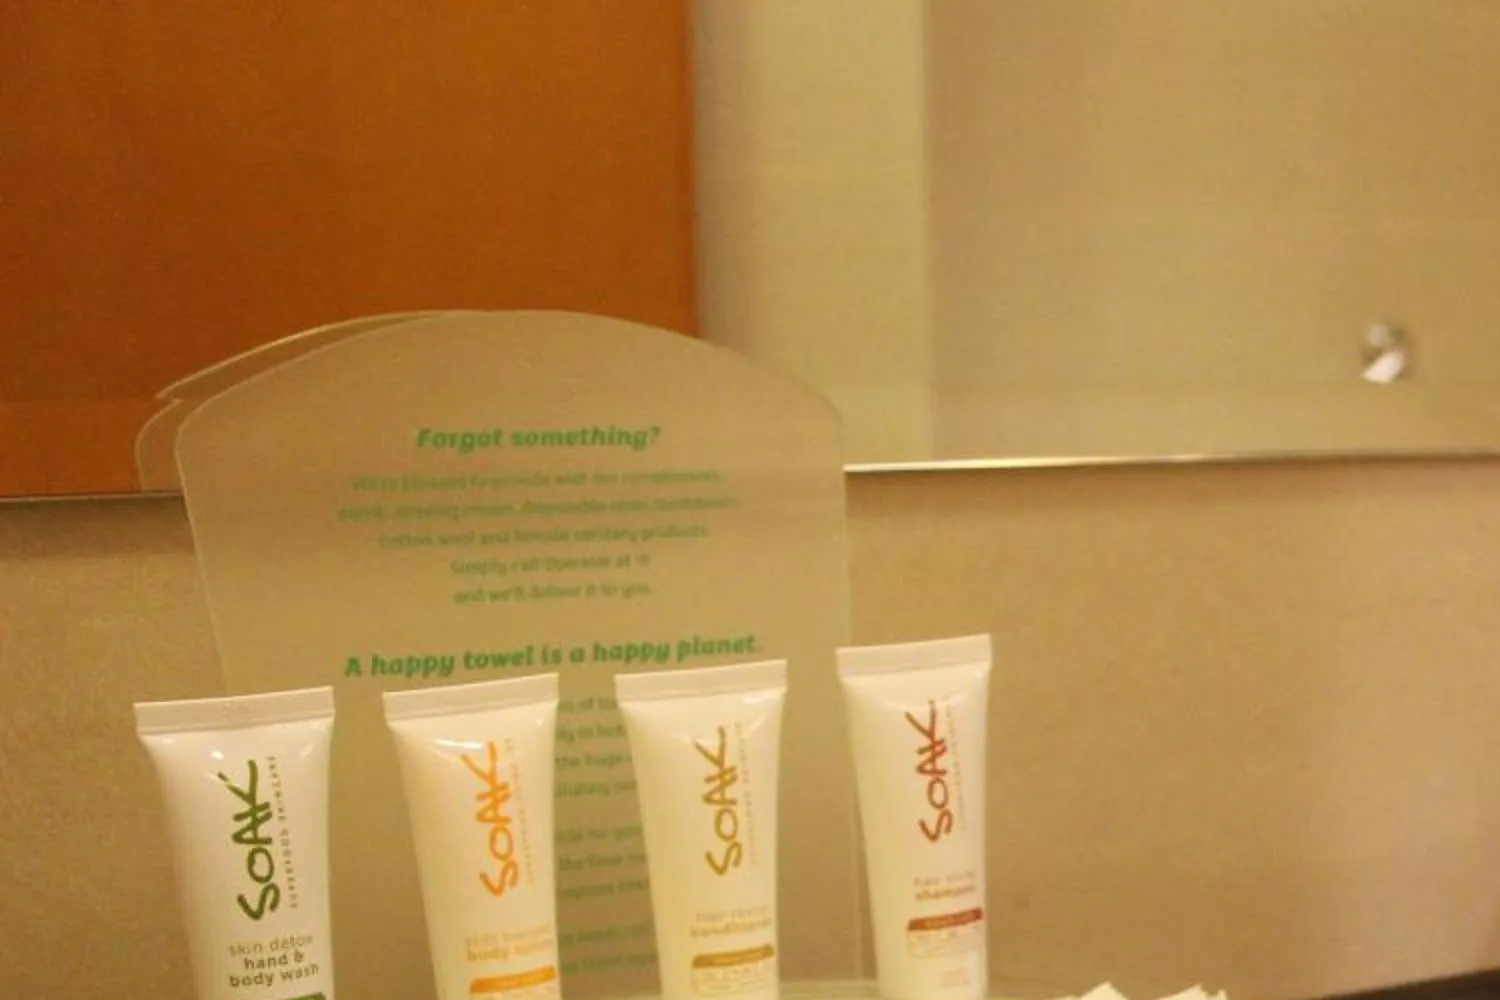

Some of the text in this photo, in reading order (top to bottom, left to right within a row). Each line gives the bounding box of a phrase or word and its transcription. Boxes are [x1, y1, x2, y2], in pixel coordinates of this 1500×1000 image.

[417, 426, 661, 452] Forgot something?
[454, 587, 487, 605] and
[345, 656, 363, 677] A
[371, 651, 455, 679] happy
[464, 645, 535, 670] towel
[541, 644, 562, 665] is
[569, 647, 585, 664] a
[593, 639, 670, 667] happy
[904, 700, 954, 843] SOAK
[694, 725, 743, 877] SOAK
[460, 740, 519, 897] SOAK
[218, 759, 281, 921] SOAK
[229, 935, 313, 958] skin detox
[243, 950, 305, 971] hand &
[229, 963, 320, 989] body wash
